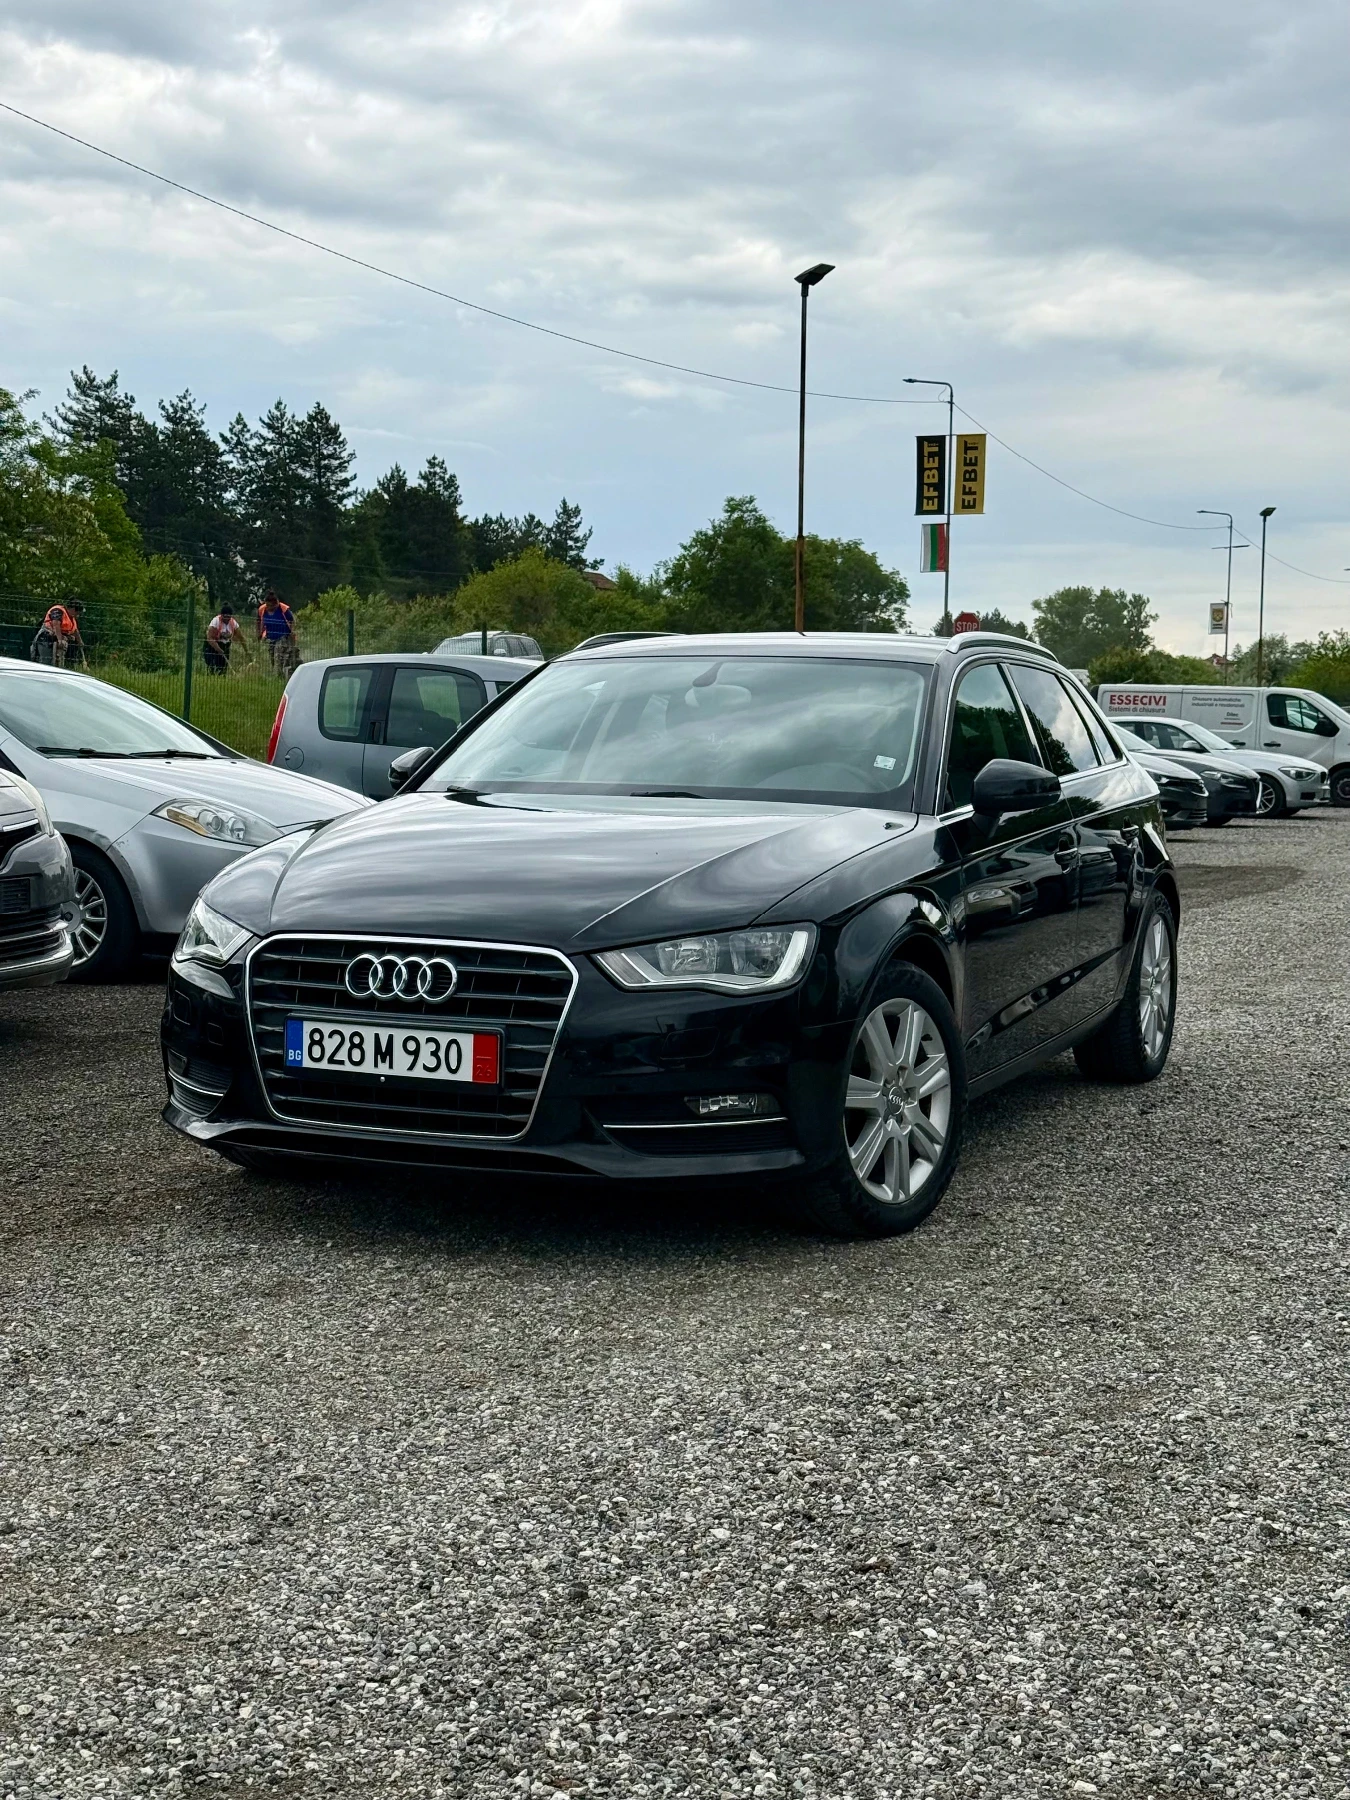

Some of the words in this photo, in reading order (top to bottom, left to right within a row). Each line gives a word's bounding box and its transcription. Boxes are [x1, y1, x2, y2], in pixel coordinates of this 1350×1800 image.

[923, 441, 939, 511] EFBET
[961, 439, 979, 510] EFBET
[956, 621, 978, 632] STOP
[1109, 694, 1167, 706] ESSECIVI
[288, 1049, 302, 1061] BG
[307, 1027, 366, 1067] 828
[373, 1032, 394, 1070] M
[401, 1034, 463, 1075] 930
